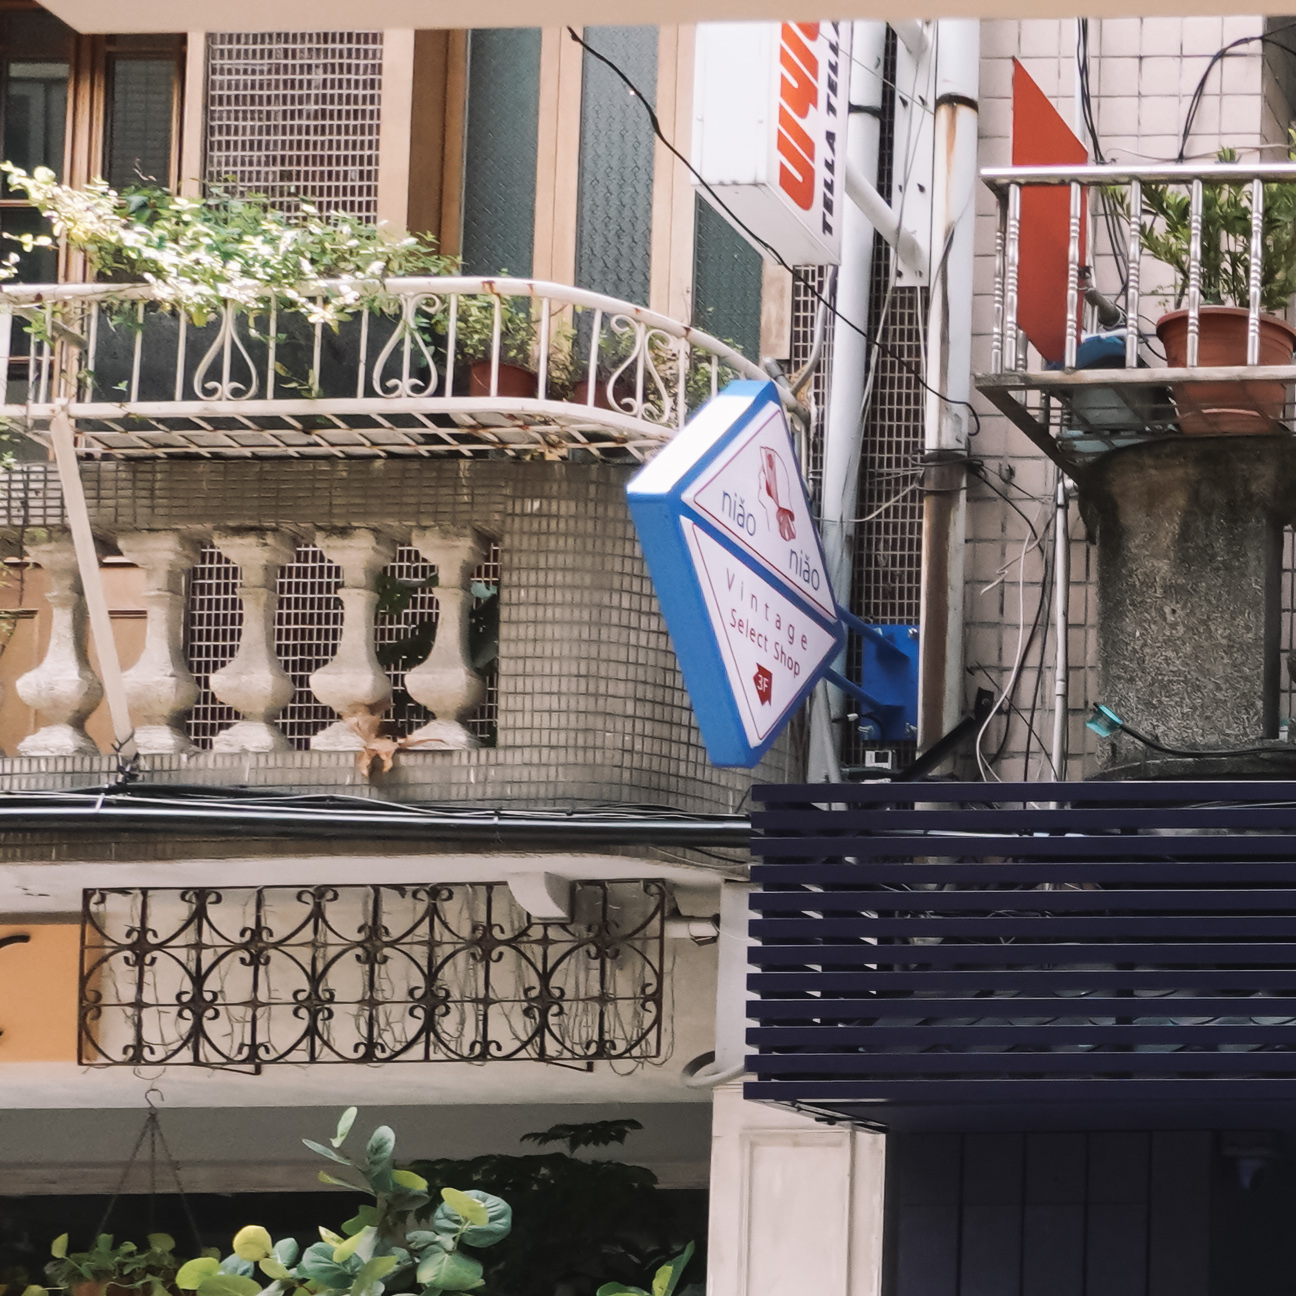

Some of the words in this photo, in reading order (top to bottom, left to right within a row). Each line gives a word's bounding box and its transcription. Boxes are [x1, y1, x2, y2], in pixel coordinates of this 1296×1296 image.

[822, 130, 836, 237] TELLA
[726, 568, 808, 651] Vintage
[730, 608, 768, 652] Select
[773, 642, 801, 679] Shop
[756, 674, 769, 693] 3F
